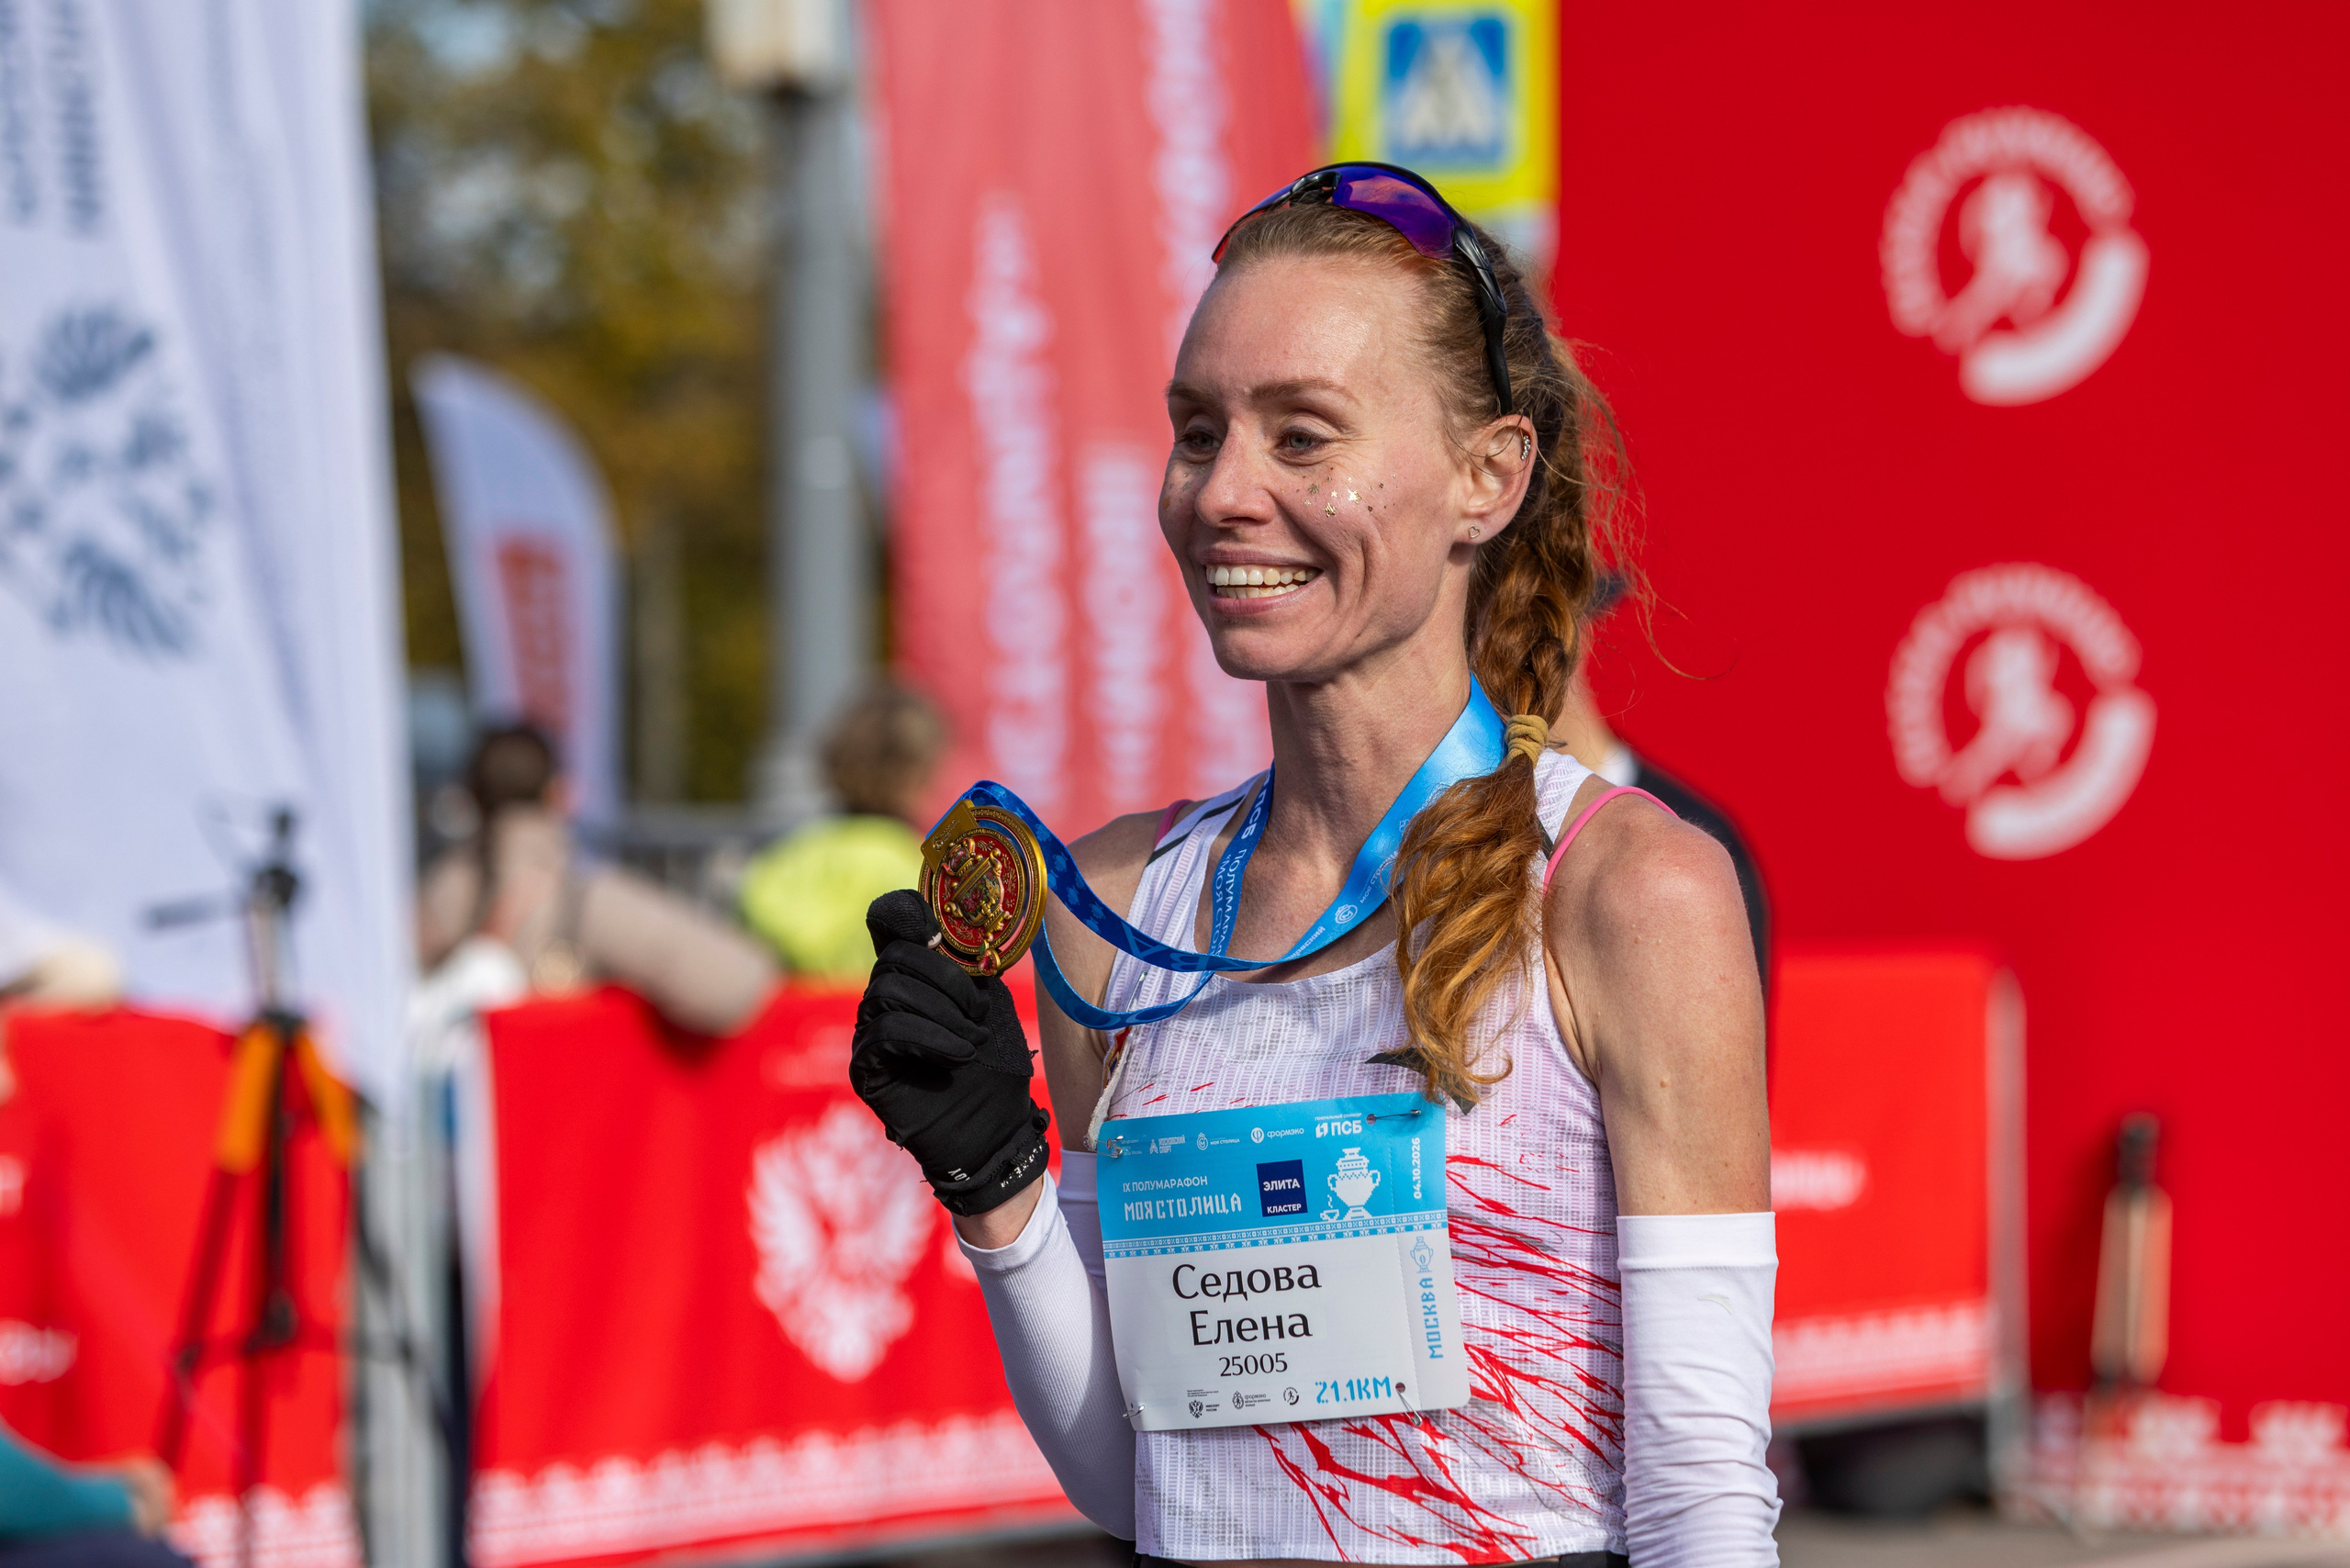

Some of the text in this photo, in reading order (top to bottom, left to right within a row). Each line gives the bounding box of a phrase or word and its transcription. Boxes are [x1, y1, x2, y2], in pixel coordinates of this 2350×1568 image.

[1215, 848, 1248, 957] ПОЛУМАРАФ
[1267, 1127, 1304, 1139] формэко
[1330, 1119, 1363, 1137] ПСБ
[1411, 1137, 1422, 1200] 04.10.2026
[1123, 1175, 1208, 1193] IX ПОЛУМАРАФОН
[1262, 1178, 1301, 1193] ЭЛИТА
[1266, 1203, 1302, 1215] КЛАСТЕР
[1172, 1263, 1322, 1304] Седова
[1190, 1309, 1313, 1347] Елена
[1418, 1277, 1444, 1360] МОСКВА
[1218, 1352, 1288, 1377] 25005
